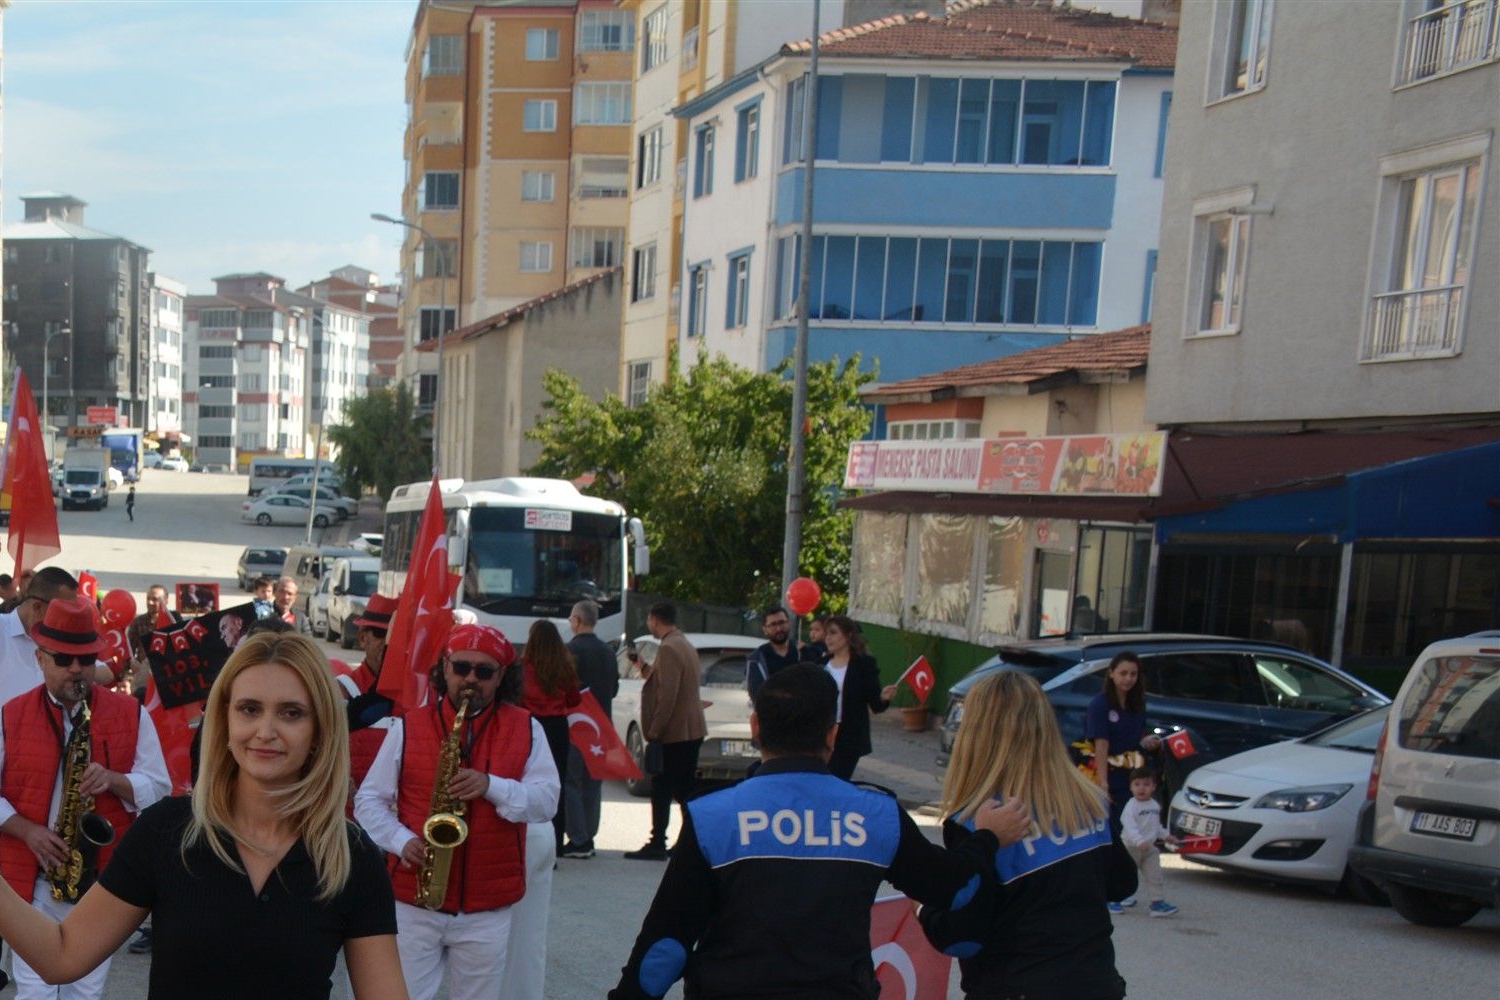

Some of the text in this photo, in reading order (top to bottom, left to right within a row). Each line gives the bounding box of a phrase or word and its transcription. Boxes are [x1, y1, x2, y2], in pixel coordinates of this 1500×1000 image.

[916, 448, 941, 479] PASTA
[943, 448, 981, 479] SALONU
[738, 809, 868, 847] POLİS
